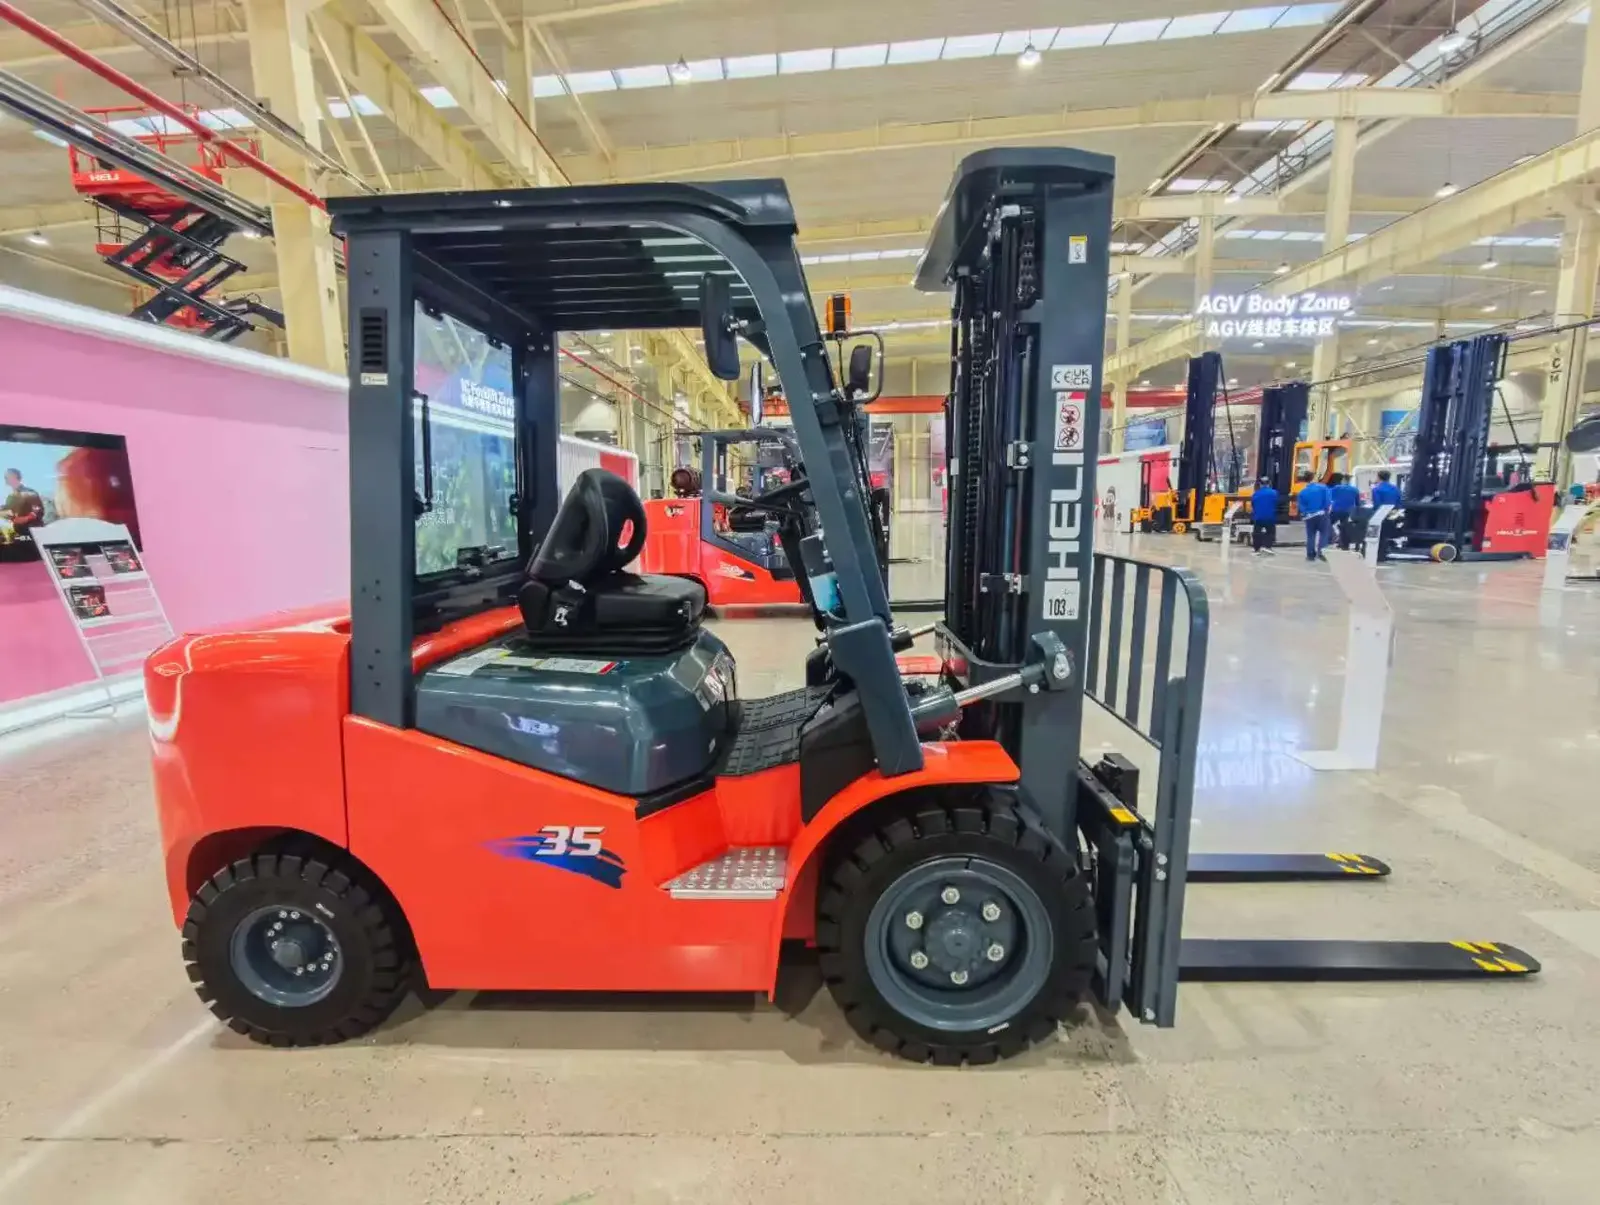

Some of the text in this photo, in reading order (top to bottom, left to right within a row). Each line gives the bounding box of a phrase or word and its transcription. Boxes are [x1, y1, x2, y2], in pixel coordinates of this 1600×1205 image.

[1196, 292, 1351, 316] AGV Body Zone
[1047, 452, 1085, 580] HELI
[1048, 598, 1067, 616] 103
[535, 825, 606, 857] 35
